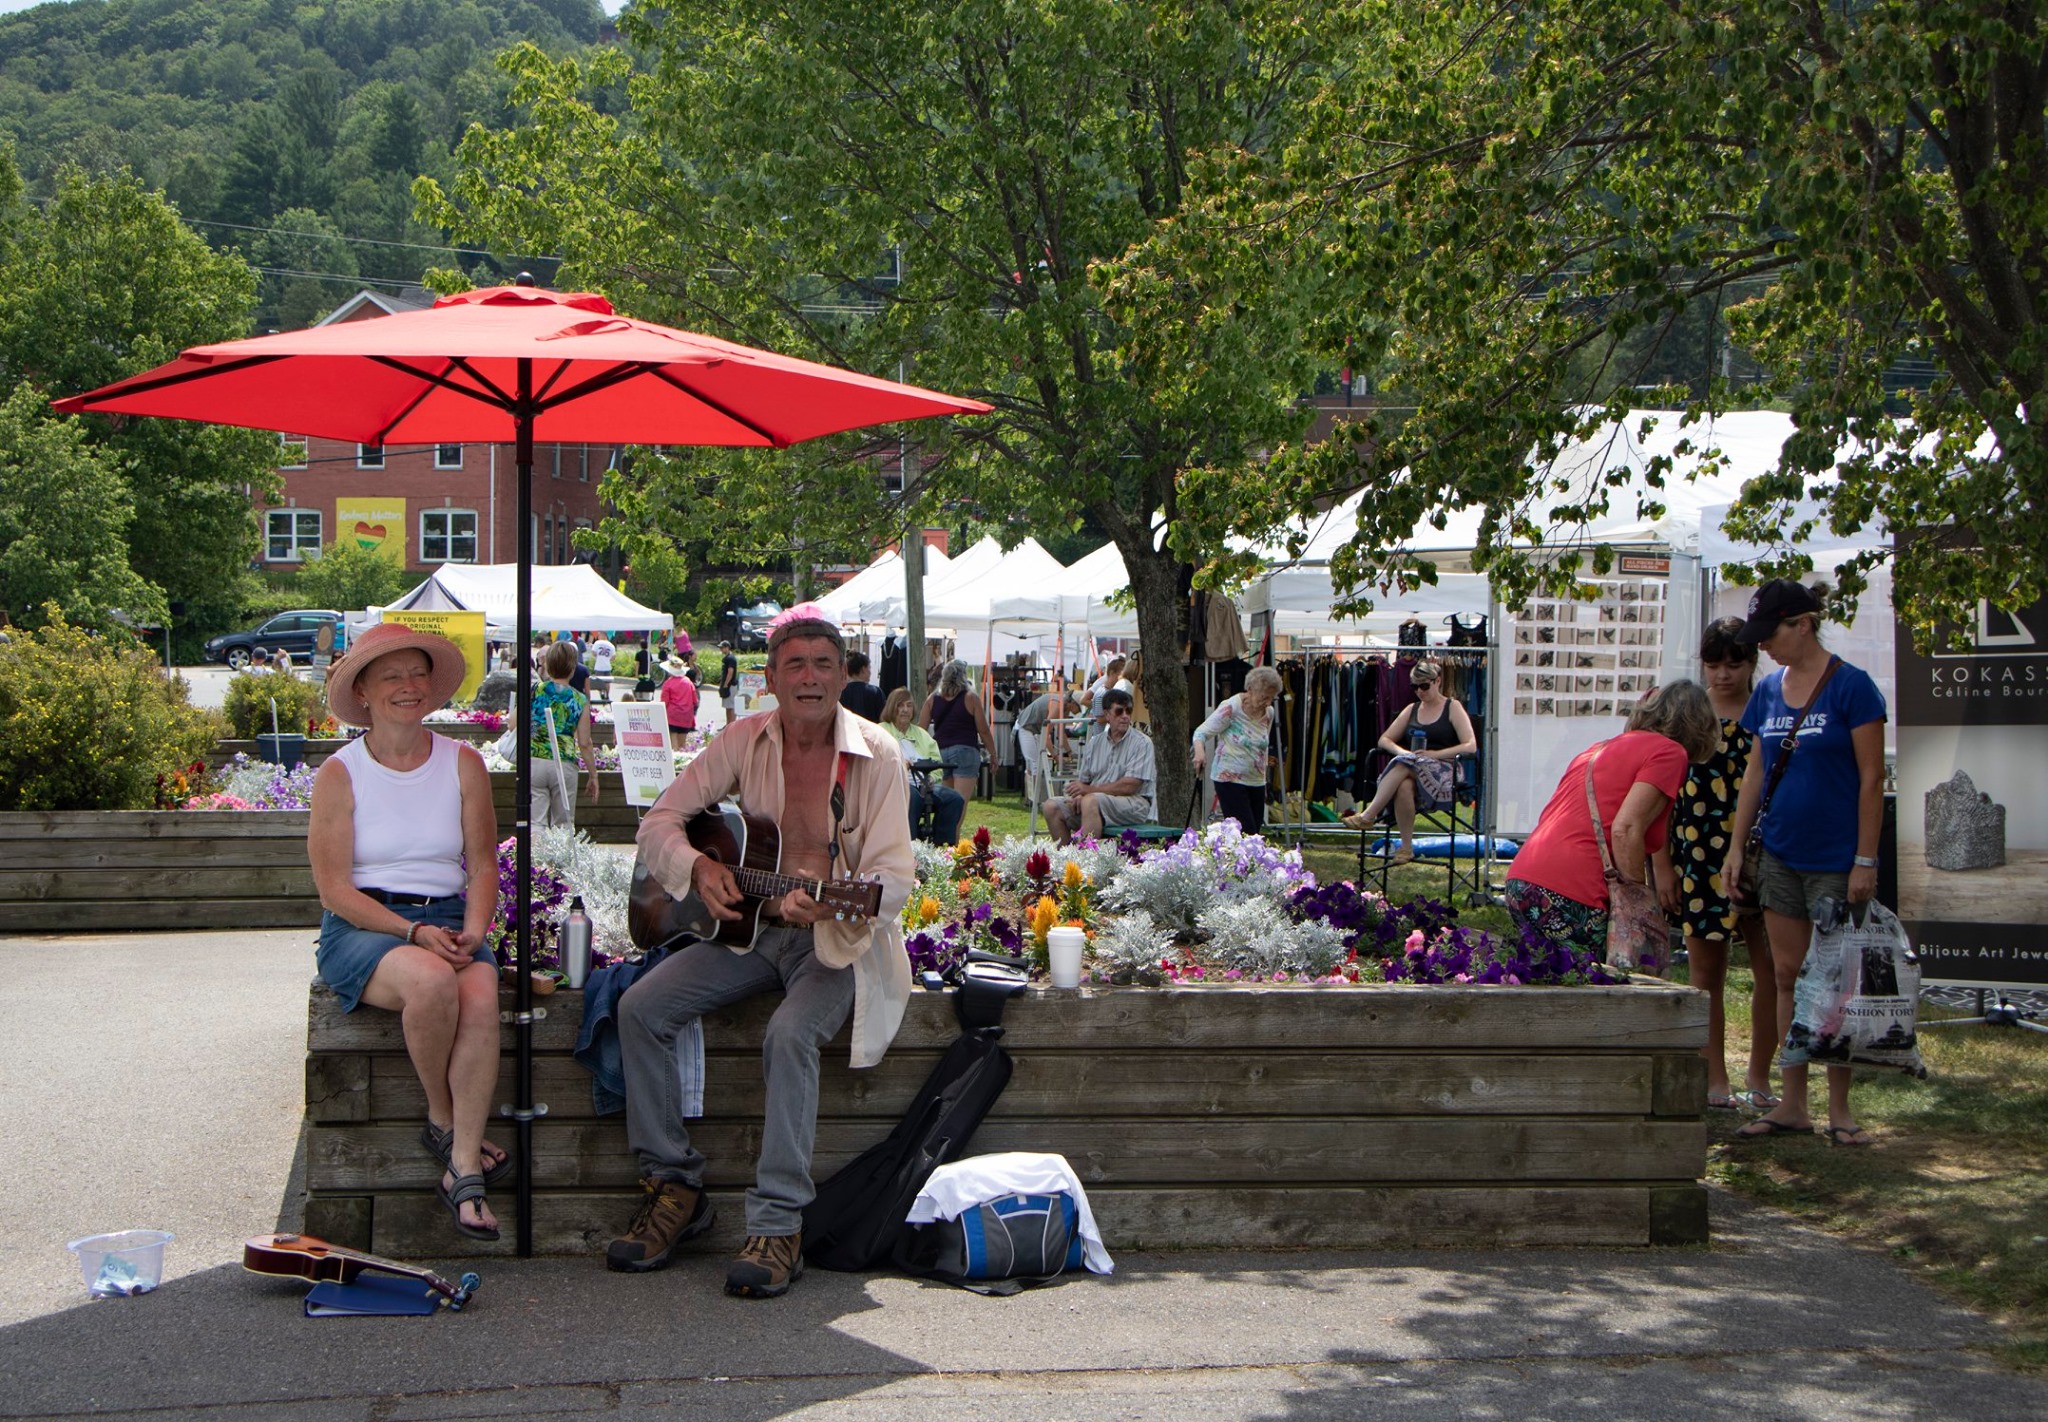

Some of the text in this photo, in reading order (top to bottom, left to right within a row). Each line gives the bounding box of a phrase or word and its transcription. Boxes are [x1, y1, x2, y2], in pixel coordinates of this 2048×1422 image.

[1931, 666, 2048, 683] KOKAS
[1932, 685, 2048, 698] Céline Bour
[629, 722, 652, 731] FESTIVAL
[1800, 713, 1827, 728] AYS
[624, 749, 640, 760] FOOD
[632, 766, 664, 779] CRAFT BEER
[1920, 944, 1970, 958] Bijoux
[1978, 946, 2004, 958] Art
[1838, 1006, 1915, 1017] FASHION TORY
